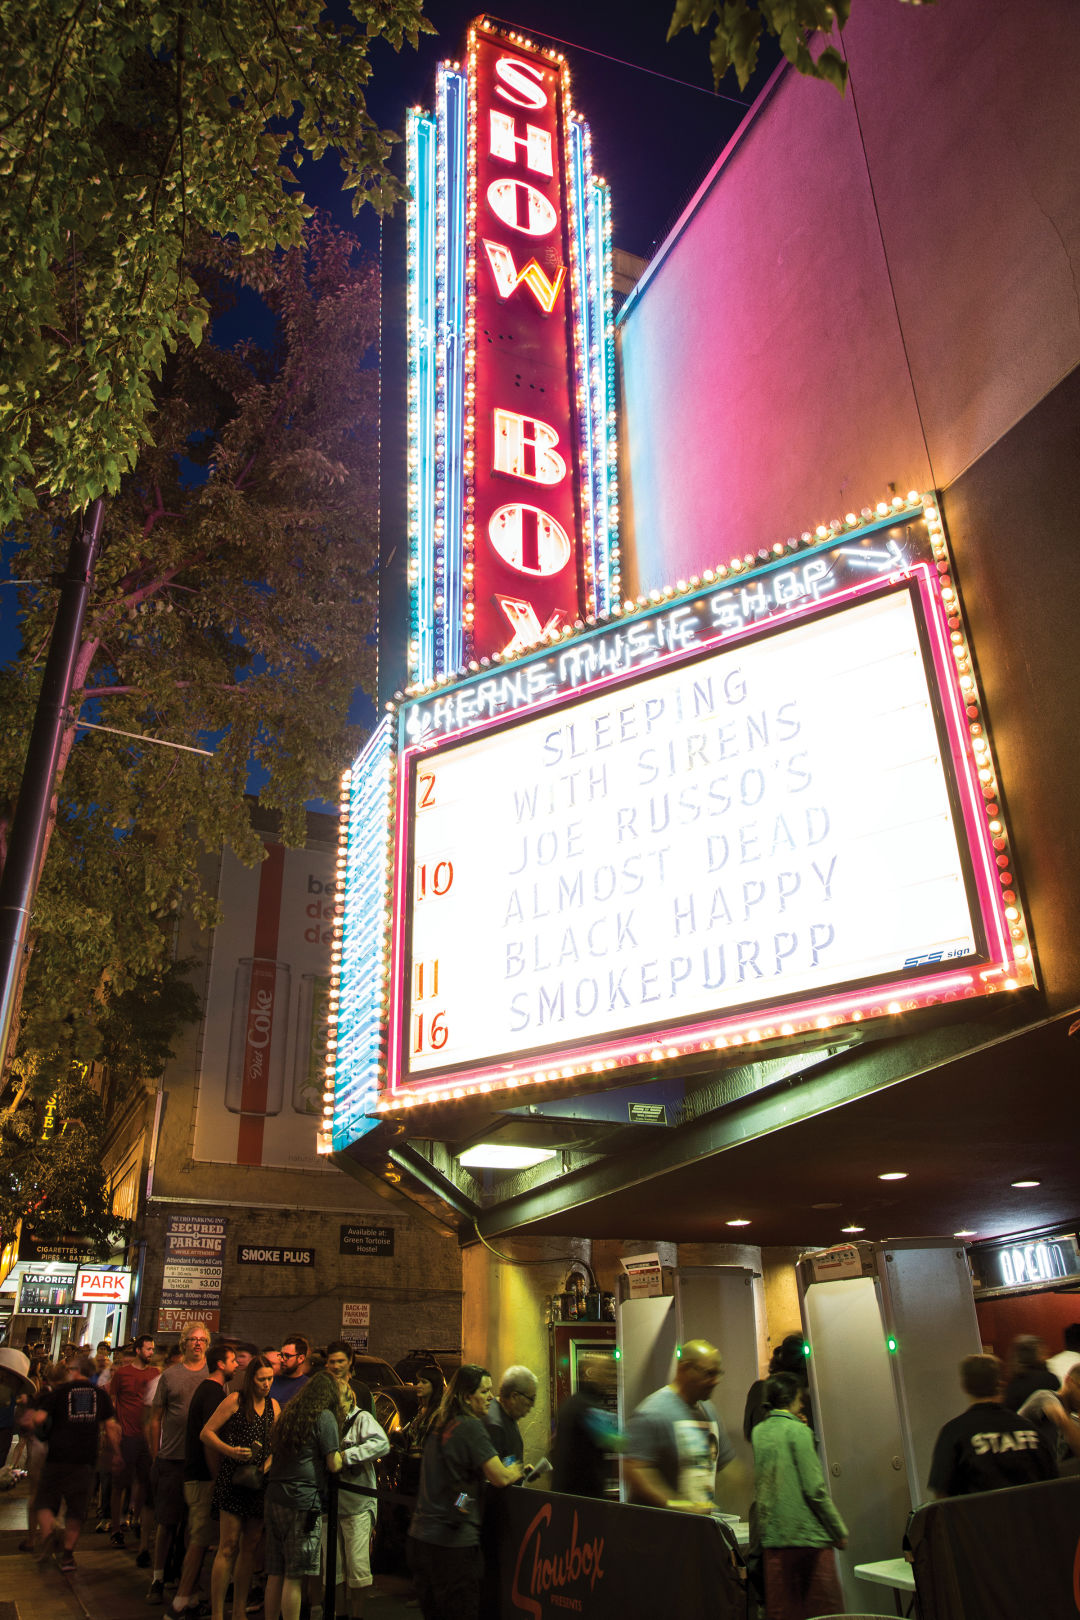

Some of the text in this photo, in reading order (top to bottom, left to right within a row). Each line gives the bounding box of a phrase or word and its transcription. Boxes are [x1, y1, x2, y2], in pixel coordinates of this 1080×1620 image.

[711, 558, 836, 634] SHOP
[543, 667, 747, 767] SLEEPING
[514, 700, 801, 824] WITH SIRENS
[417, 771, 437, 809] 2
[508, 750, 812, 875] JOE RUSSO'S
[416, 860, 454, 901] 10
[501, 806, 831, 928] ALMOST DEAD
[504, 854, 837, 979] BLACK HAPPY
[947, 947, 970, 957] sign
[414, 958, 439, 1001] 11
[508, 923, 835, 1032] SMOKEPURPP
[247, 989, 273, 1049] Coke
[413, 1009, 448, 1054] 16
[169, 1237, 222, 1251] PARKING
[171, 1223, 224, 1234] SECURED
[343, 1236, 391, 1245] Green Tortoise
[348, 1228, 377, 1236] Available
[36, 1246, 78, 1254] CIGARETTES
[241, 1248, 311, 1263] SMOKE PLUS
[999, 1244, 1067, 1285] OPEN
[80, 1274, 126, 1289] PARK
[199, 1268, 222, 1276] $10.00
[199, 1280, 220, 1288] $3.00
[165, 1311, 213, 1320] EVENING
[970, 1430, 1040, 1455] STAFF
[511, 1503, 605, 1620] Showbox
[550, 1594, 582, 1612] PRESENTS
